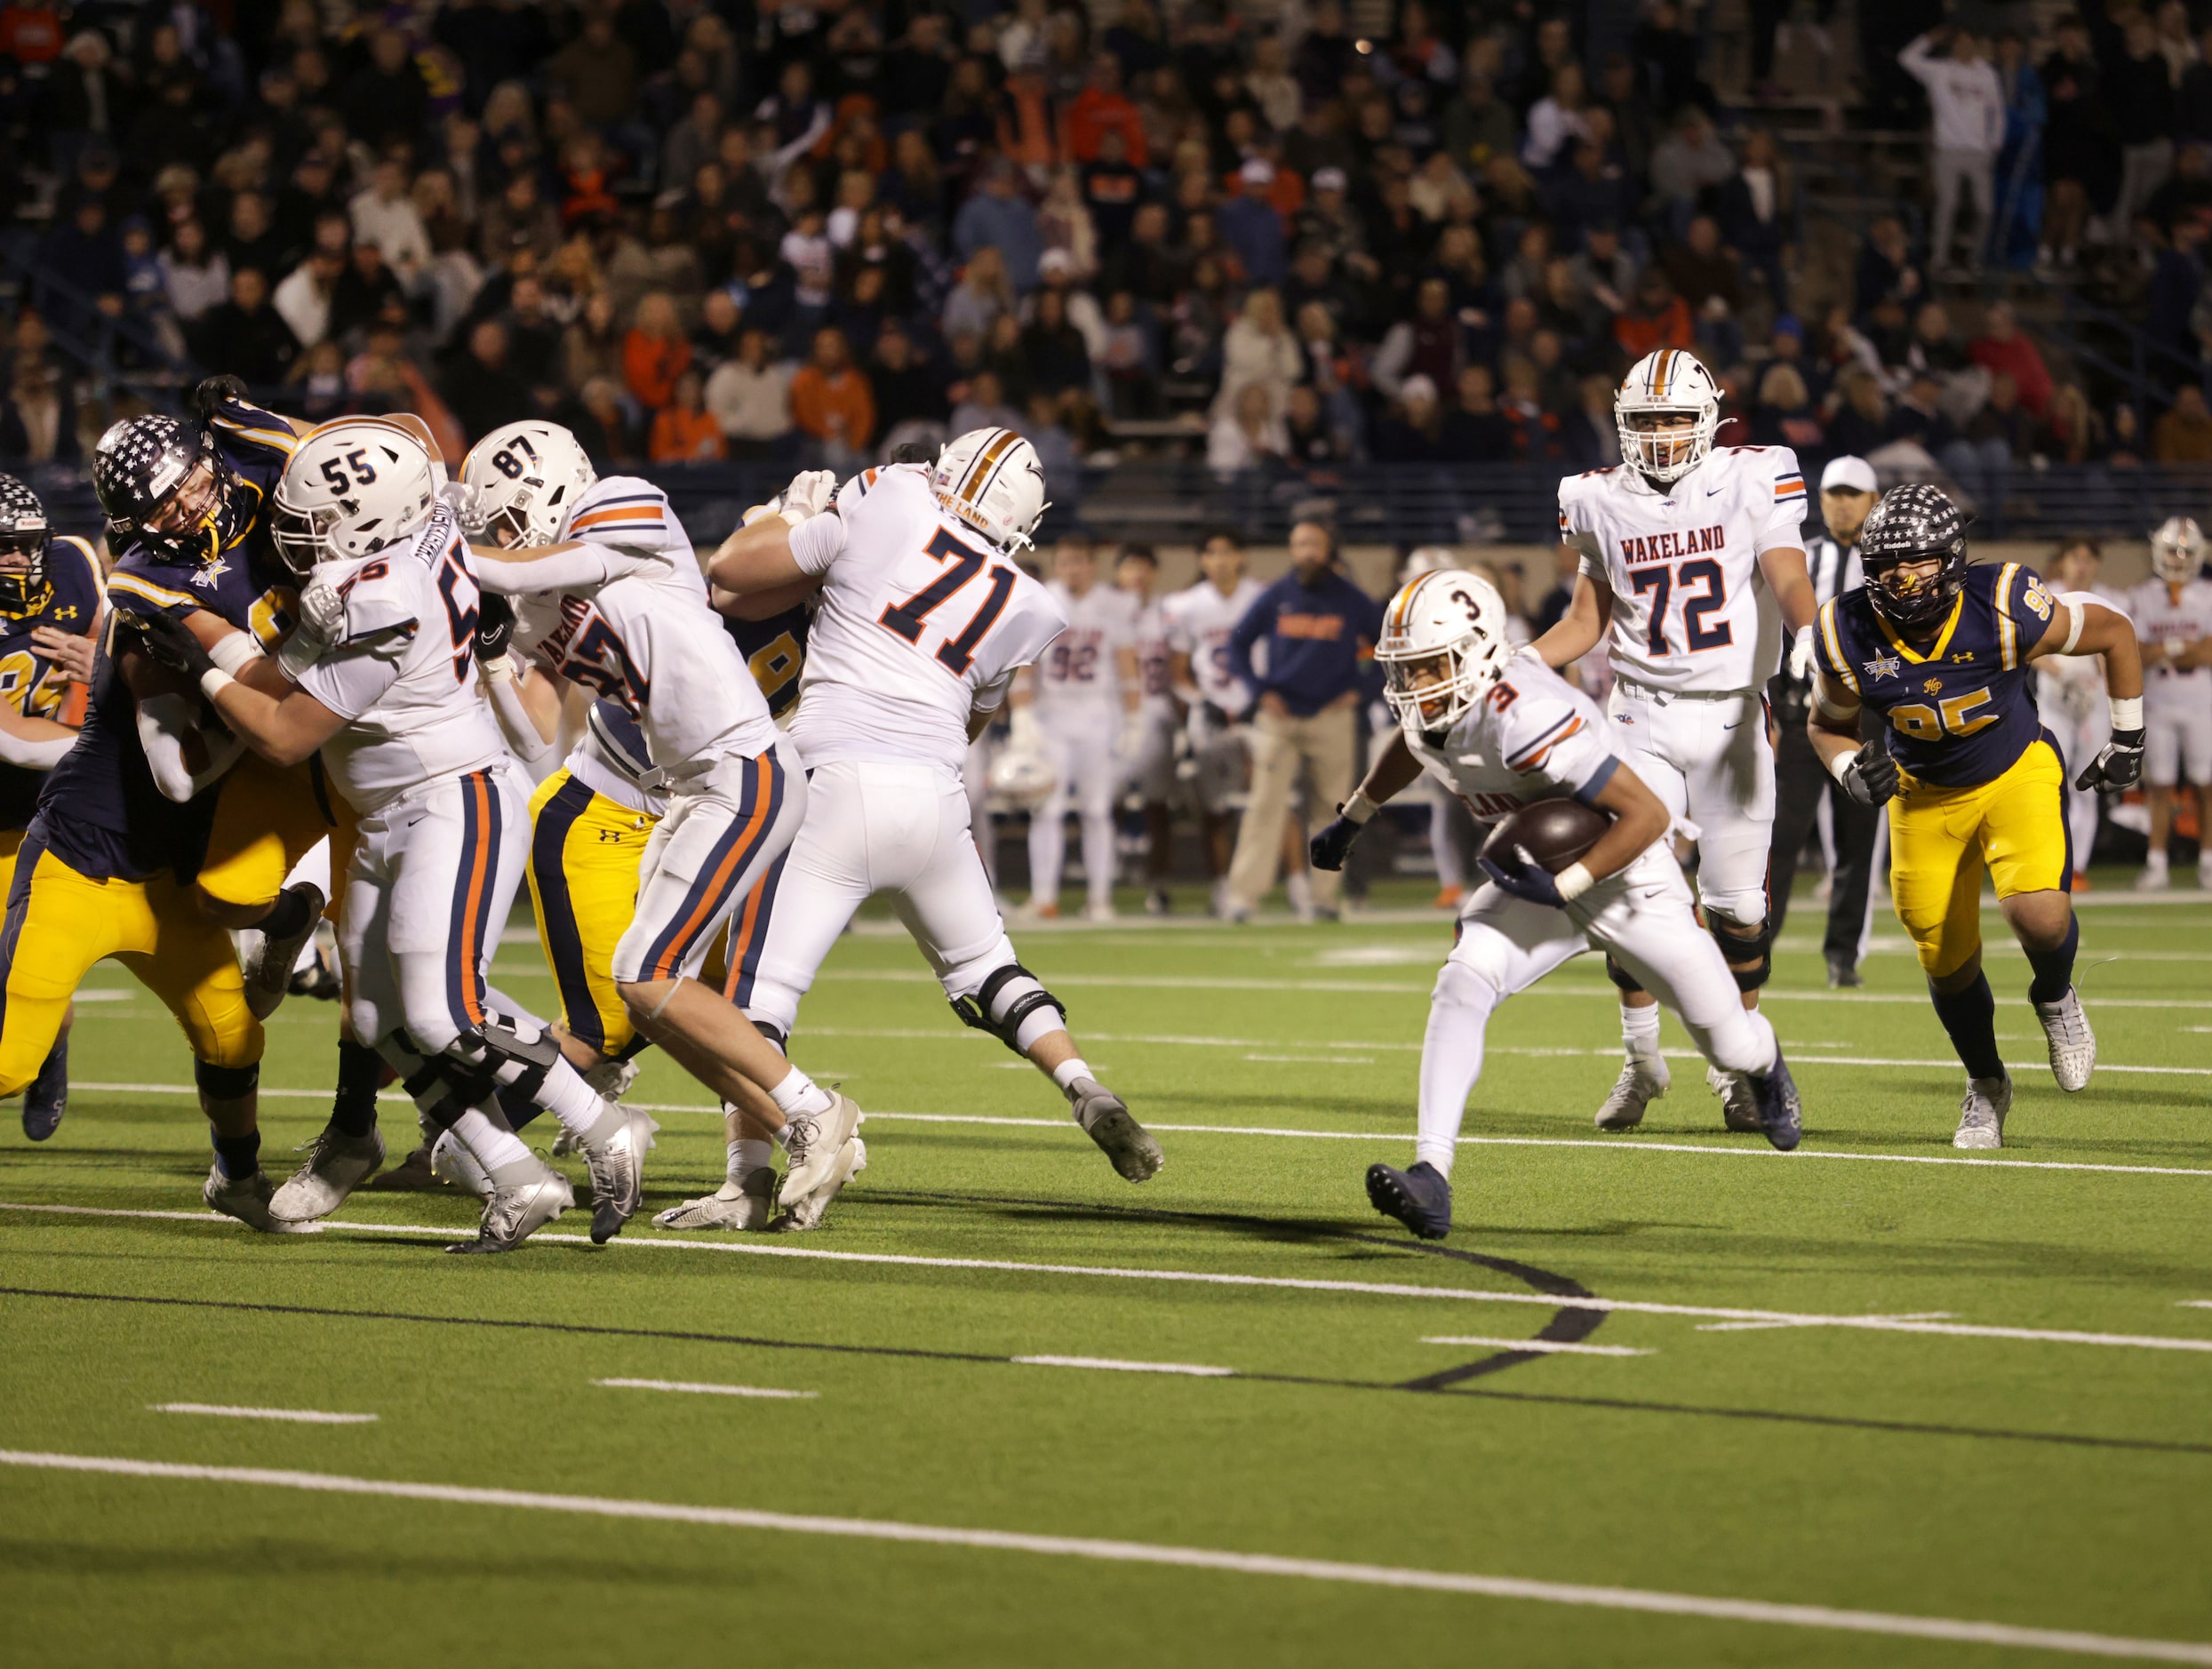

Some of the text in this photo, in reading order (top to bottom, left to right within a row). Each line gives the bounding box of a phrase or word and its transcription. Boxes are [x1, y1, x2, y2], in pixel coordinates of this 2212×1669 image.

[320, 448, 377, 496] 55
[492, 435, 538, 480] 87
[935, 491, 955, 507] THE
[955, 500, 988, 529] LAND
[1620, 524, 1726, 565] WAKELAND
[877, 524, 1018, 679] 71
[1451, 590, 1481, 620] 3
[1628, 557, 1734, 658] 72
[2023, 576, 2053, 621] 95
[1486, 682, 1520, 715] 3
[1014, 992, 1045, 1013] DONJOY
